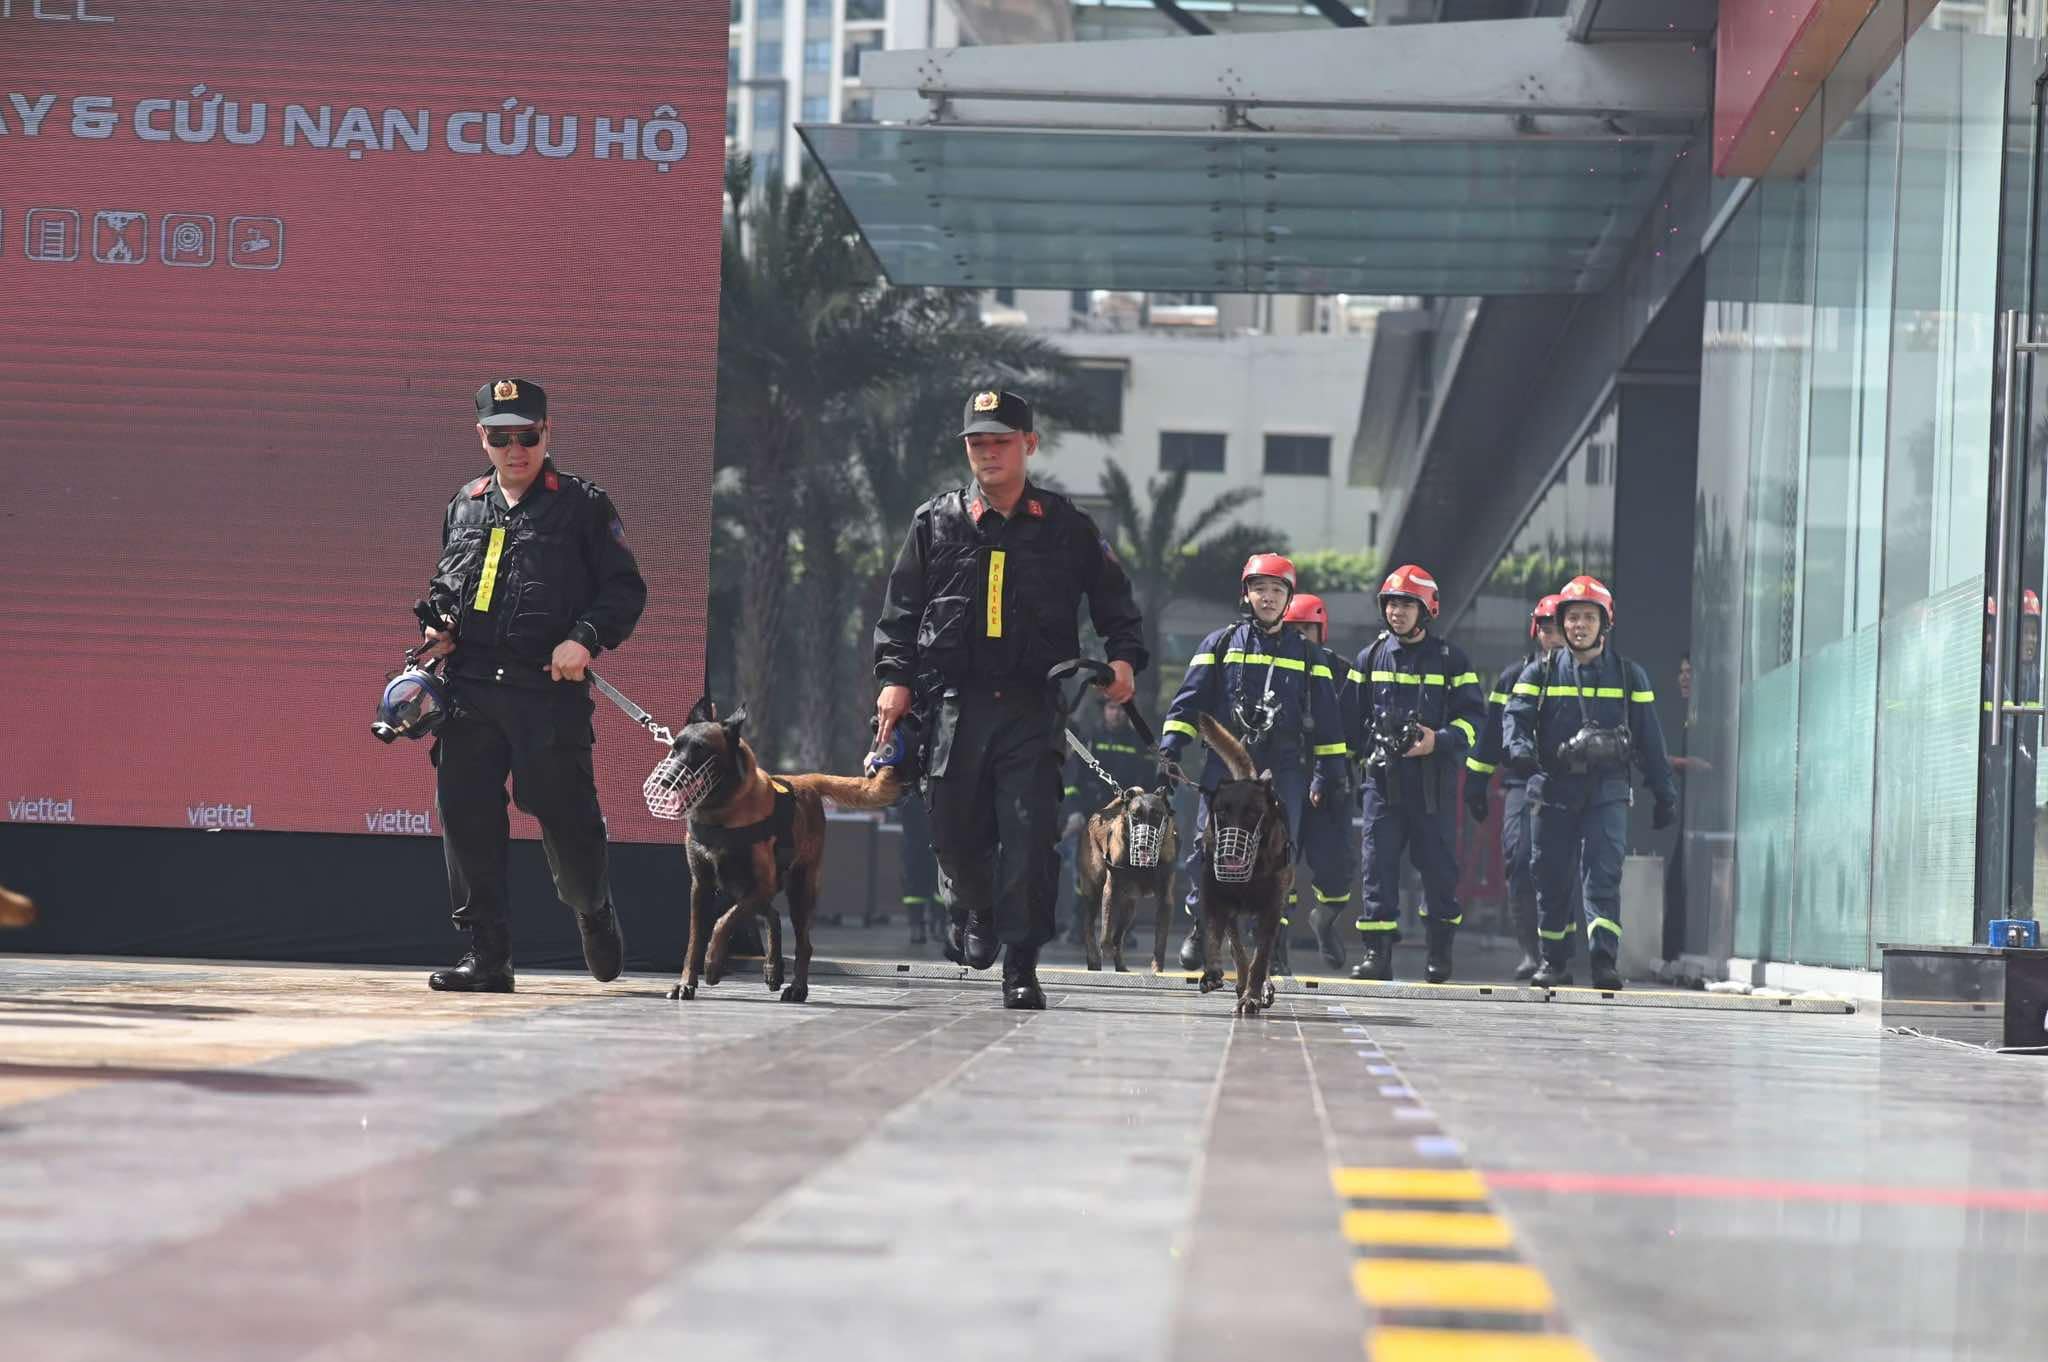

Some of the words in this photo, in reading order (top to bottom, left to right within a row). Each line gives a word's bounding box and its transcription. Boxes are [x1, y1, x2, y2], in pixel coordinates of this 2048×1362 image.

[0, 92, 57, 136] Y
[71, 95, 119, 138] &
[134, 83, 267, 144] CỨU
[284, 104, 430, 160] NẠN
[446, 96, 578, 157] CỨU
[593, 105, 688, 173] HỘ
[991, 563, 1000, 625] POLICE
[8, 796, 75, 822] viettel
[186, 802, 255, 828] viettel
[365, 808, 432, 833] viettel
